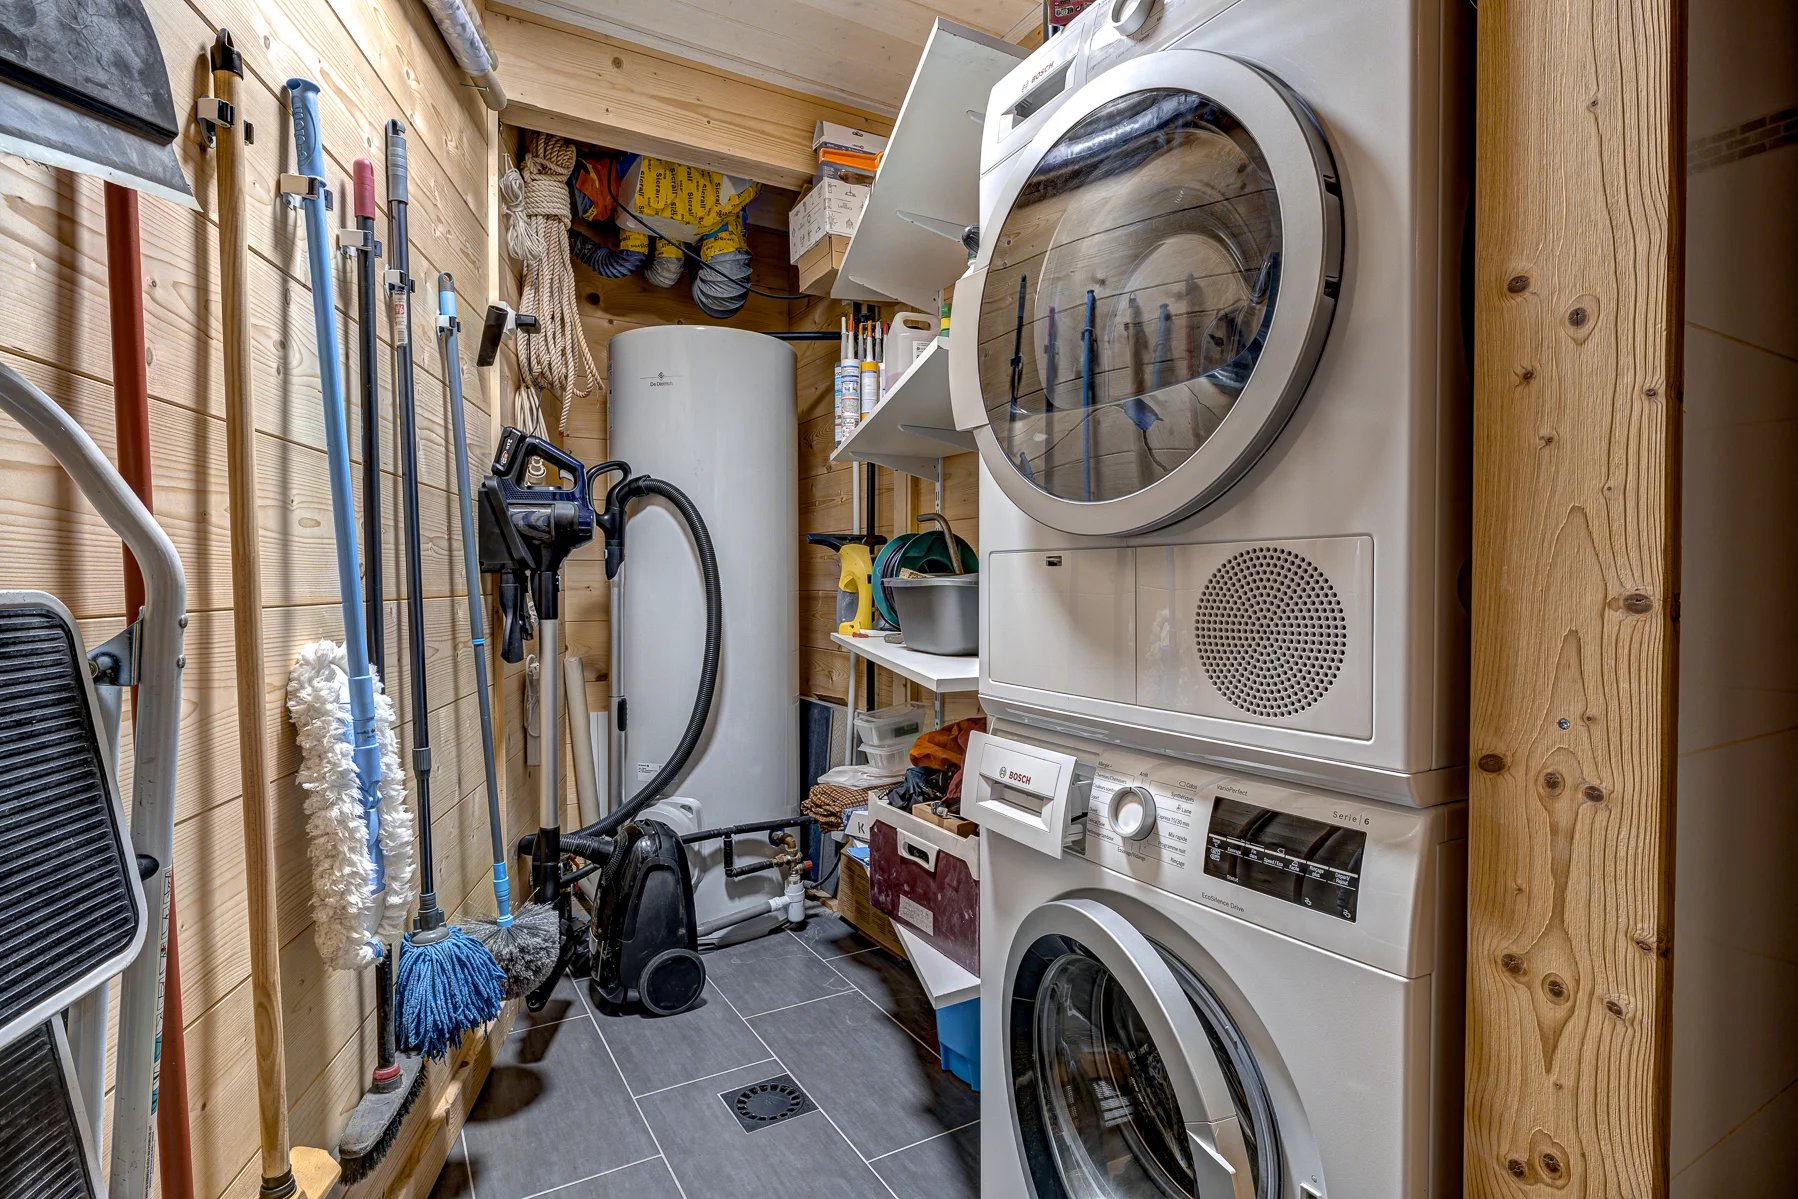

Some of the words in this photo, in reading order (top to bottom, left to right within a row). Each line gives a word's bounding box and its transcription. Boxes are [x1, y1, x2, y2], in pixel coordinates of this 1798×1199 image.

[1031, 60, 1055, 83] BOSCH
[1008, 771, 1032, 785] BOSCH
[1217, 784, 1248, 797] VarioPerfect
[1332, 810, 1357, 823] Serie
[1364, 817, 1370, 826] 6
[1201, 892, 1229, 907] EcoSilence
[1231, 902, 1245, 913] Drive
